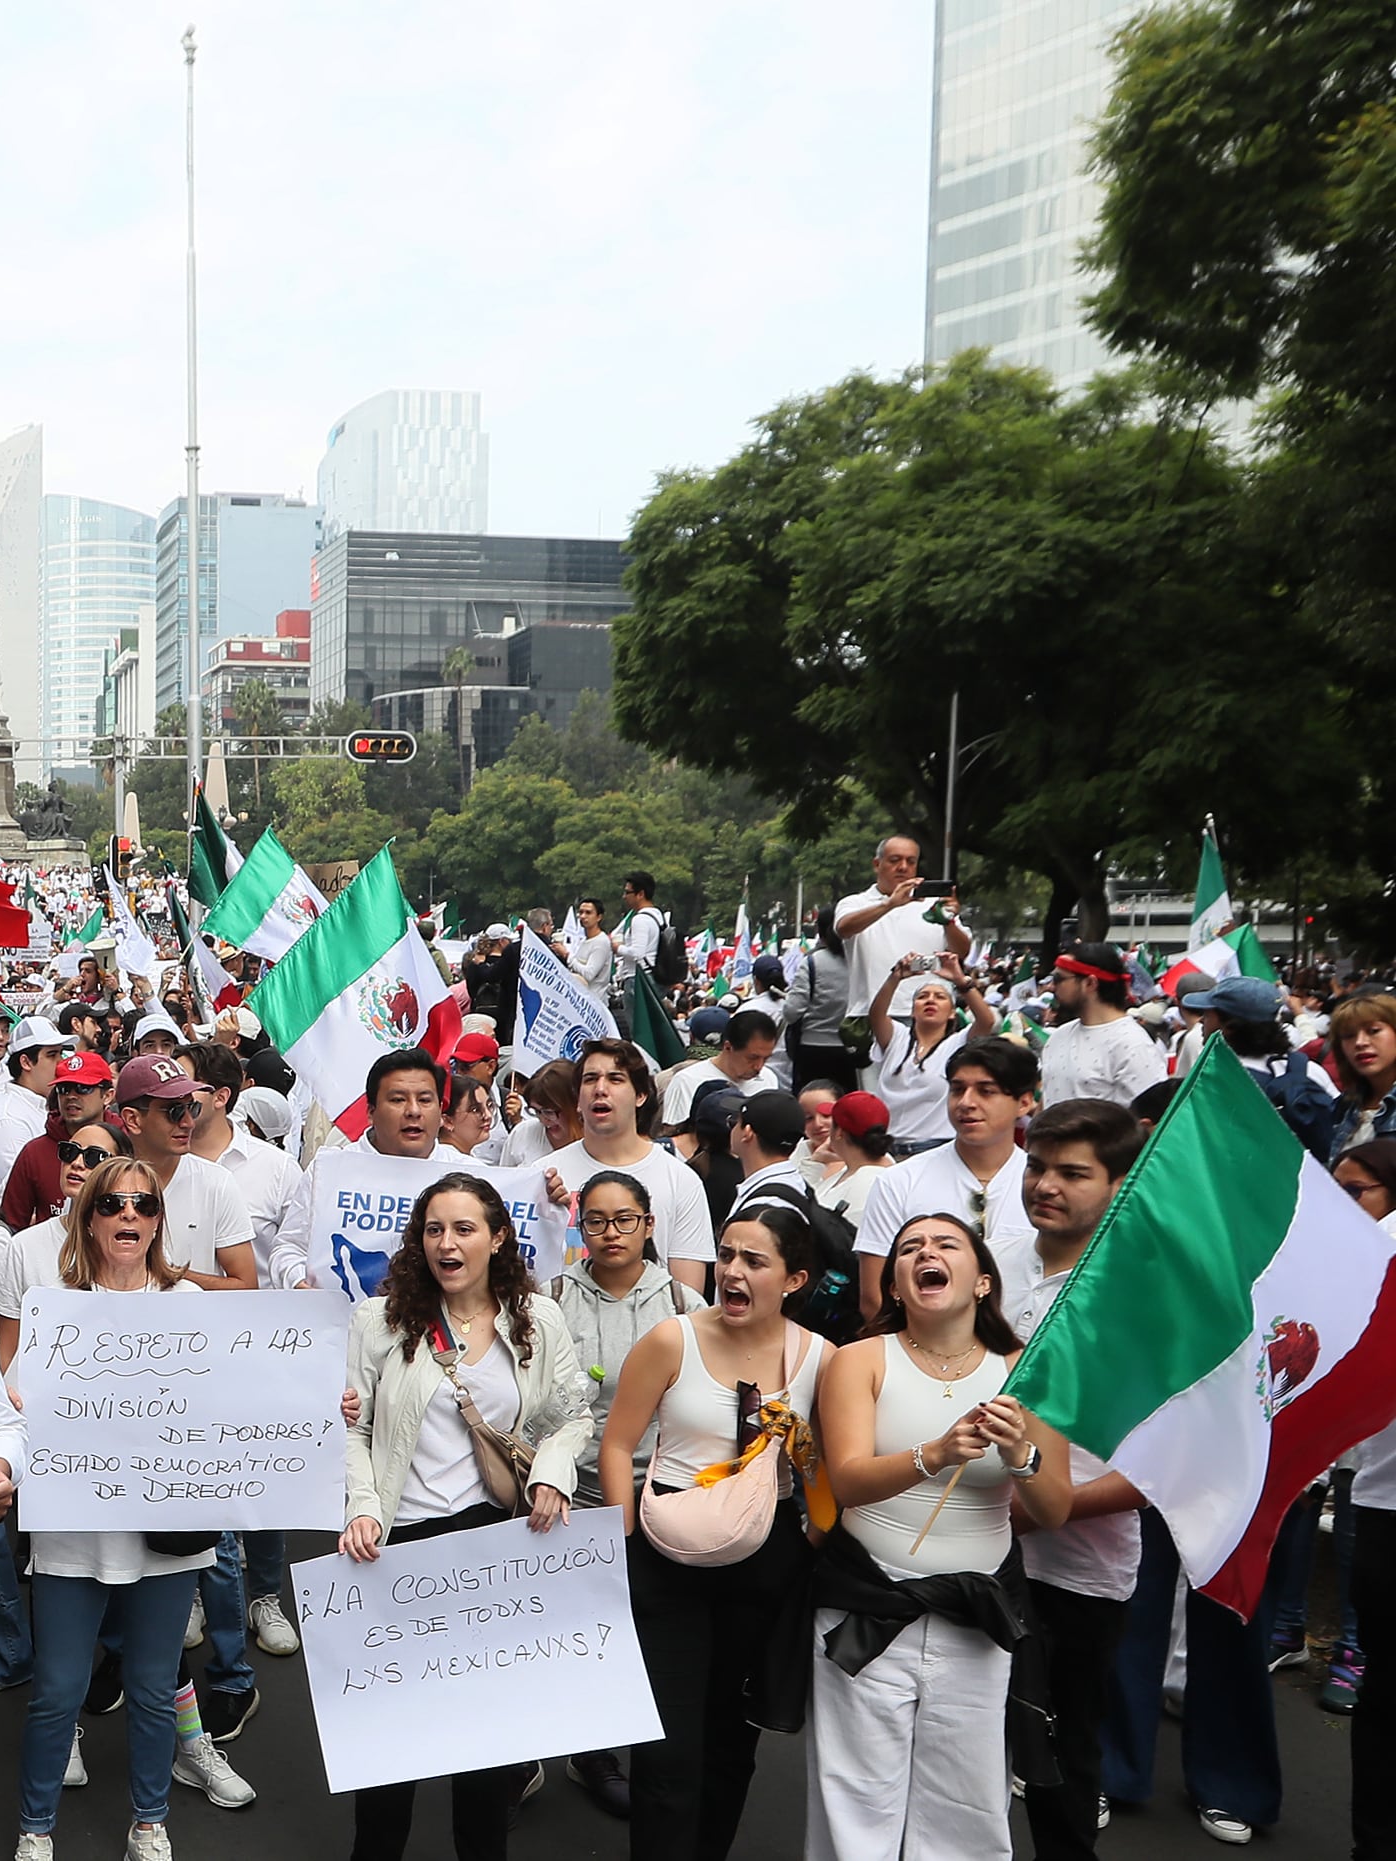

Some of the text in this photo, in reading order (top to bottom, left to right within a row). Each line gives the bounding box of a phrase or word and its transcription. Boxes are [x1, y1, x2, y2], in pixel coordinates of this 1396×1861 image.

[337, 1191, 371, 1211] EN
[379, 1195, 413, 1213] DE
[342, 1211, 407, 1233] PODE
[230, 1330, 253, 1354] A
[268, 1327, 313, 1355] LAS
[159, 1425, 207, 1445] DE
[29, 1448, 306, 1476] ESTADO DEMOCRÁTICO
[92, 1476, 266, 1503] DE DERECHO
[391, 1537, 617, 1605] CONSTITUCIÓN
[364, 1596, 545, 1648] ES DE TODXS
[342, 1623, 612, 1695] LXS MEXICANXS!
